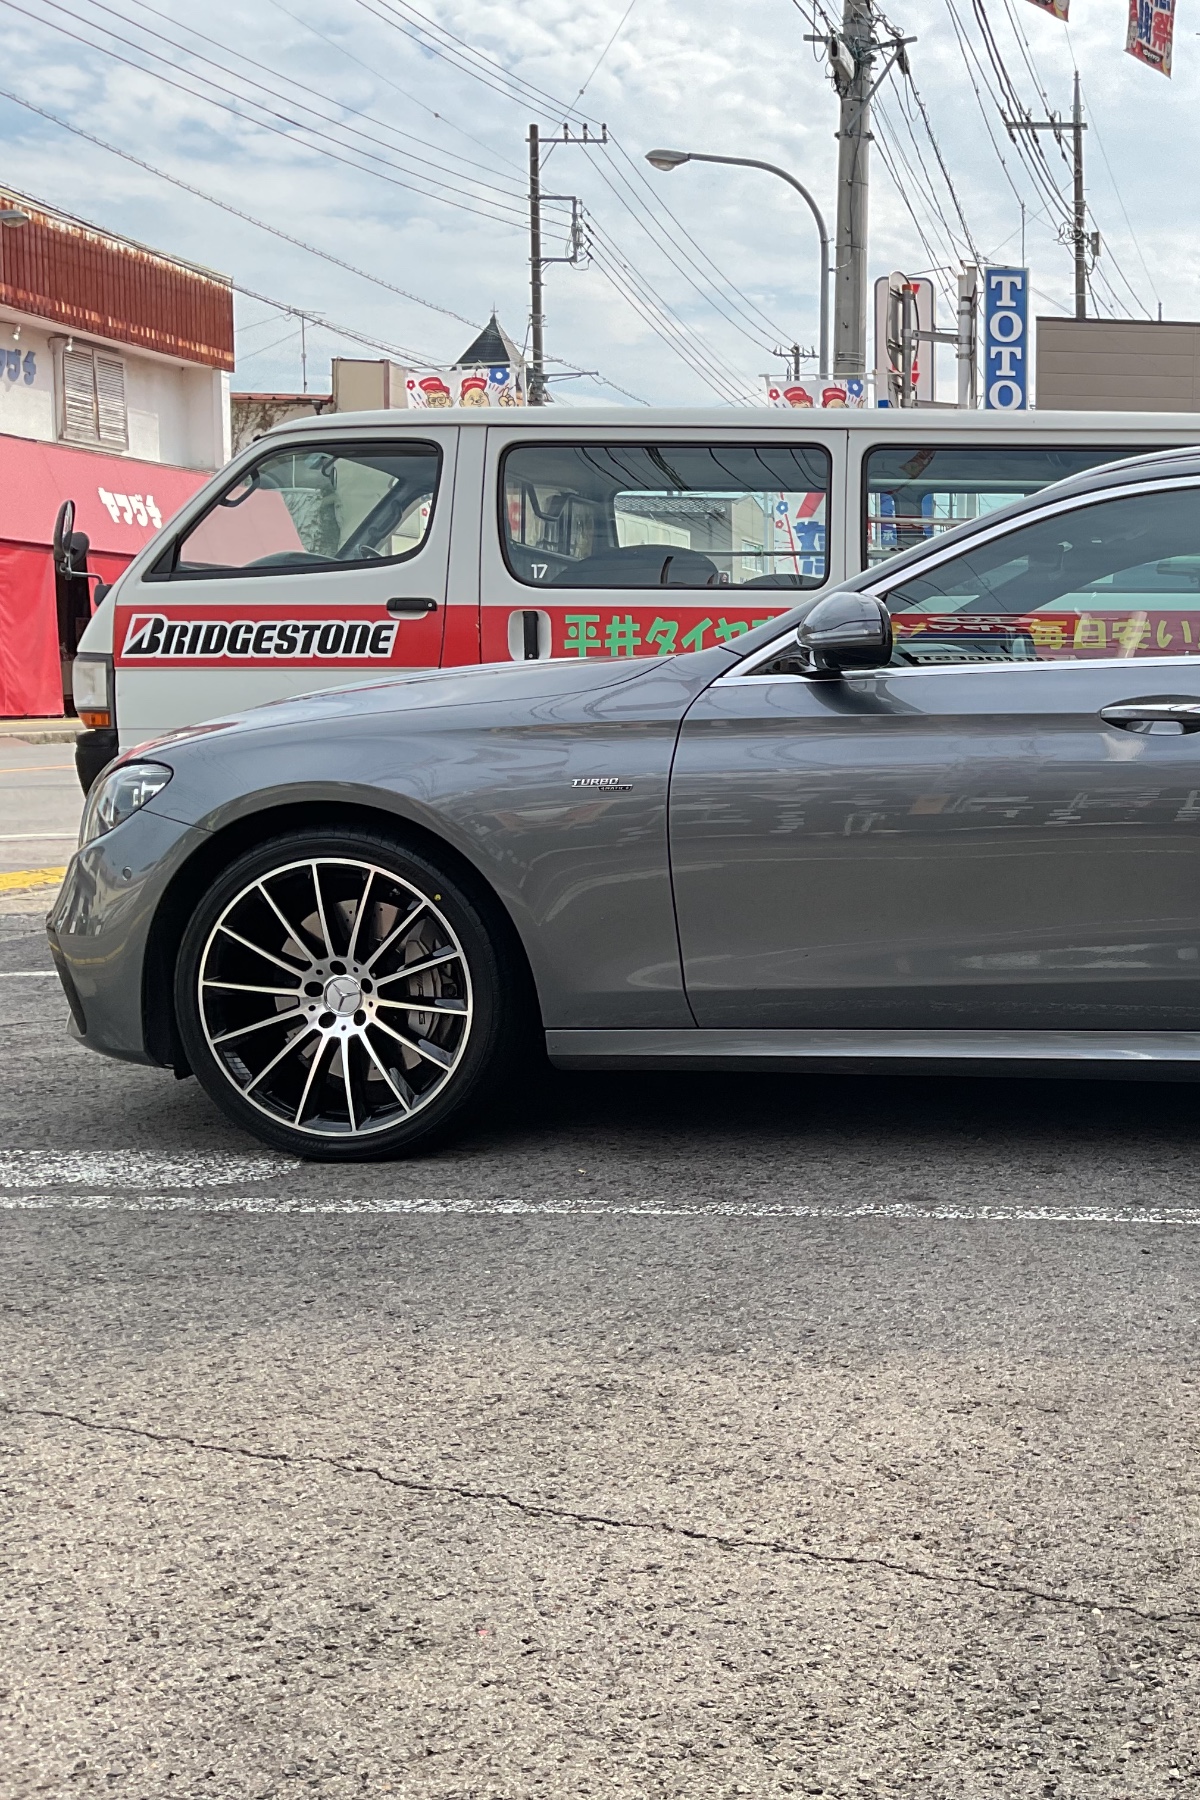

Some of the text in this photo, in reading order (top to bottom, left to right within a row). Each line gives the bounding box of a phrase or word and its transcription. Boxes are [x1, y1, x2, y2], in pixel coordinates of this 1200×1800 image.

[988, 275, 1023, 410] TOTO
[0, 348, 37, 386] グチ
[531, 563, 548, 579] 17
[123, 617, 396, 656] BRIDGESTONE
[564, 614, 775, 657] 平井タイヤ
[571, 777, 619, 786] TURBO
